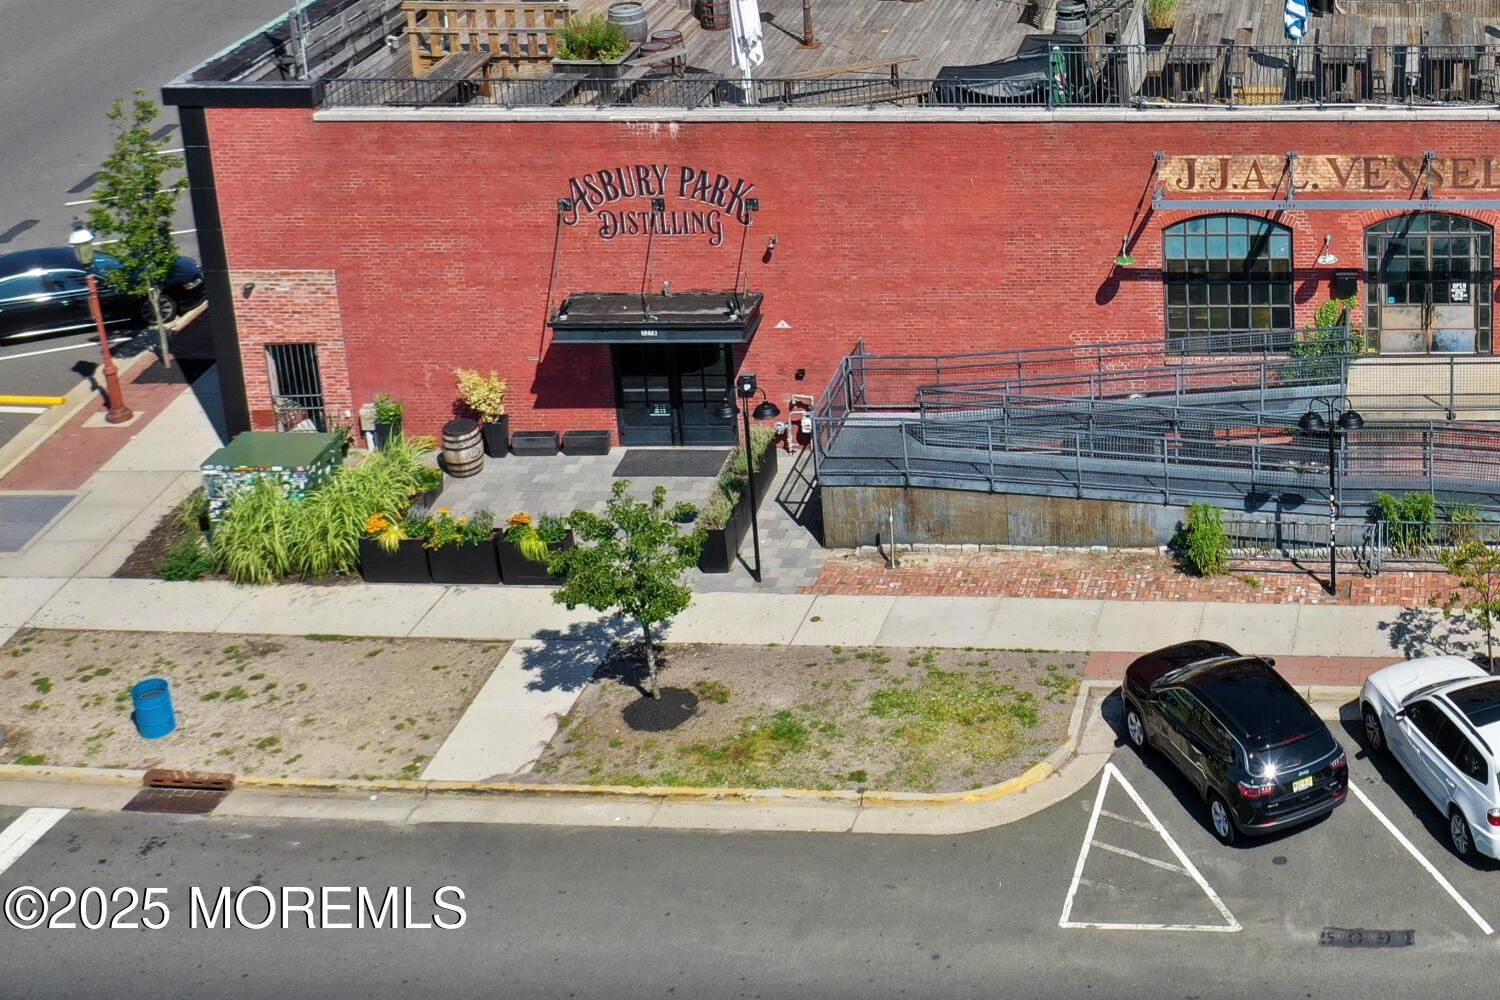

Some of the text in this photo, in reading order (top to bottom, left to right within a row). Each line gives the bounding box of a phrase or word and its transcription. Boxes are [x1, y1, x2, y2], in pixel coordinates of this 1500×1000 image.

[563, 163, 755, 226] ASBURY PARK
[597, 210, 724, 247] DISTILLING
